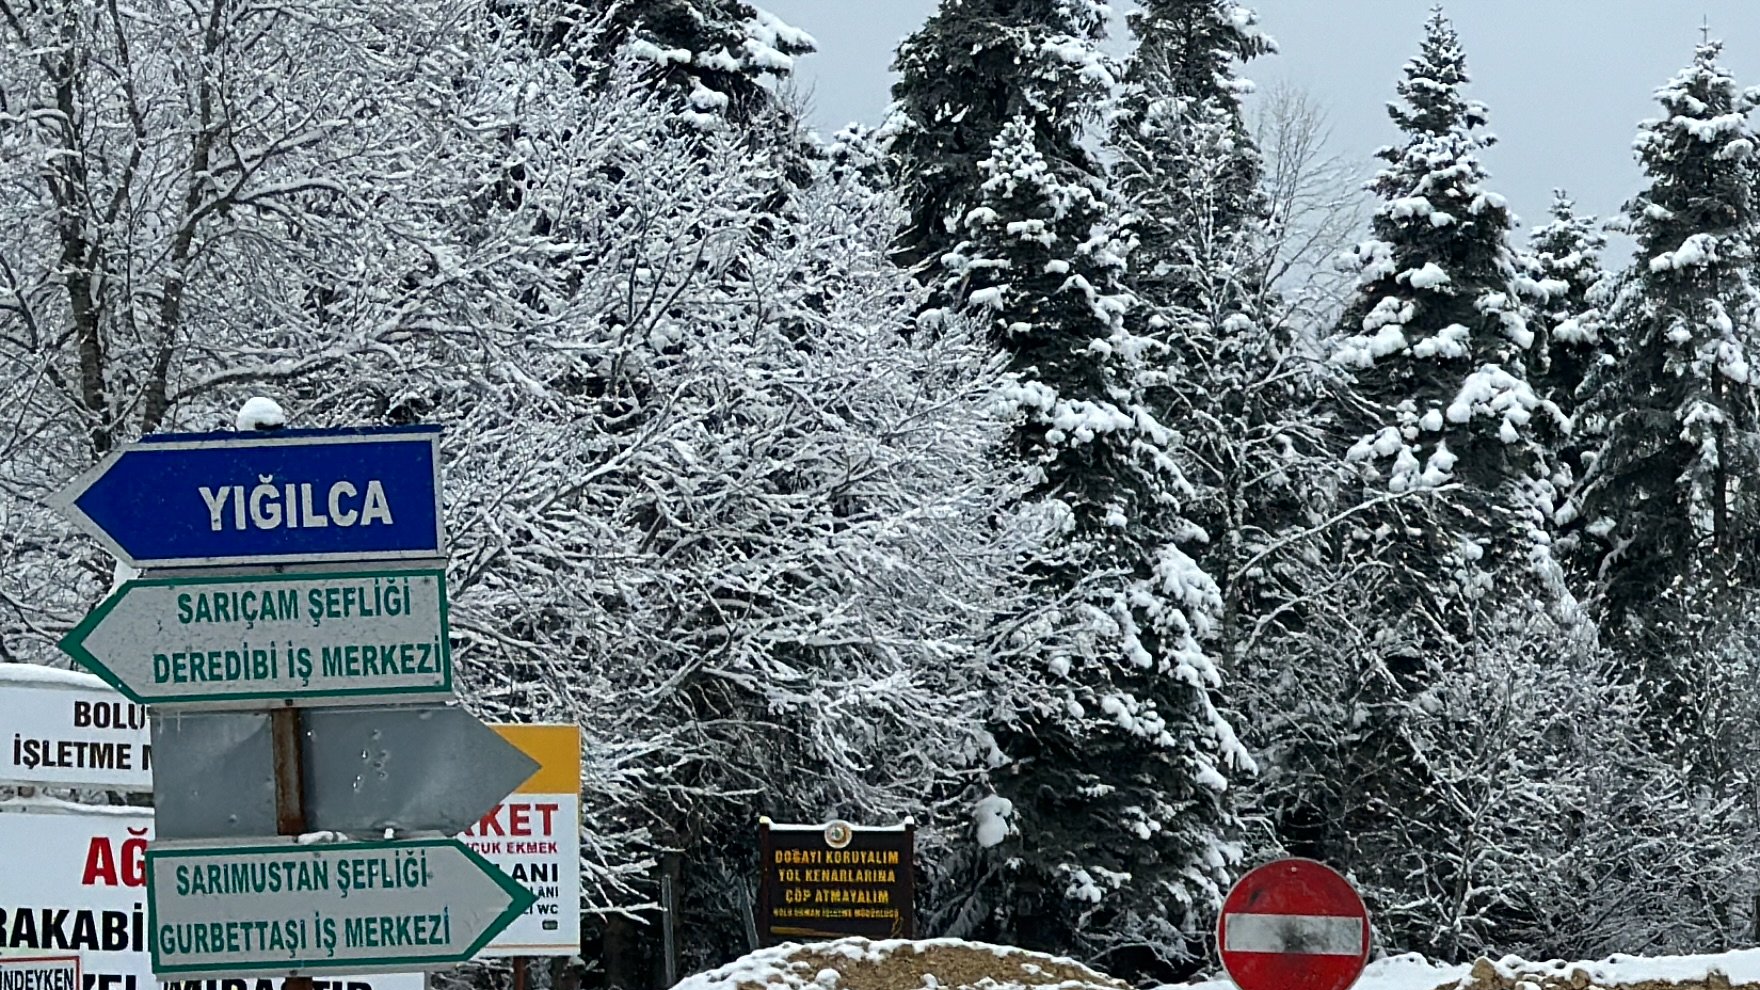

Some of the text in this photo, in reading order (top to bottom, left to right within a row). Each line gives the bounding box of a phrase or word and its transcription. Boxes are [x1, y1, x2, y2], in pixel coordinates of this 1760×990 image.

[198, 473, 394, 532] YIĞILCA
[177, 576, 411, 630] SARIÇAM ŞEFLİĞİ
[153, 634, 442, 687] DEREDİBİ İŞ MERKEZİ
[74, 700, 146, 730] BOLU
[13, 733, 132, 770] İŞLETME
[464, 803, 559, 837] KET
[467, 842, 558, 854] CUK EKMEK
[775, 848, 899, 864] DOĞAYI KORUYALIM
[176, 848, 429, 899] SARIMUSTAN ŞEFLİĞİ
[495, 862, 559, 883] ANI
[779, 868, 896, 883] YOL KENARLARINA
[537, 903, 558, 915] WC
[785, 887, 889, 904] ÇÖP ATMAYALIM
[0, 902, 152, 952] AKABİ
[159, 903, 451, 959] GURBETTAŞI İŞ MERKEZİ
